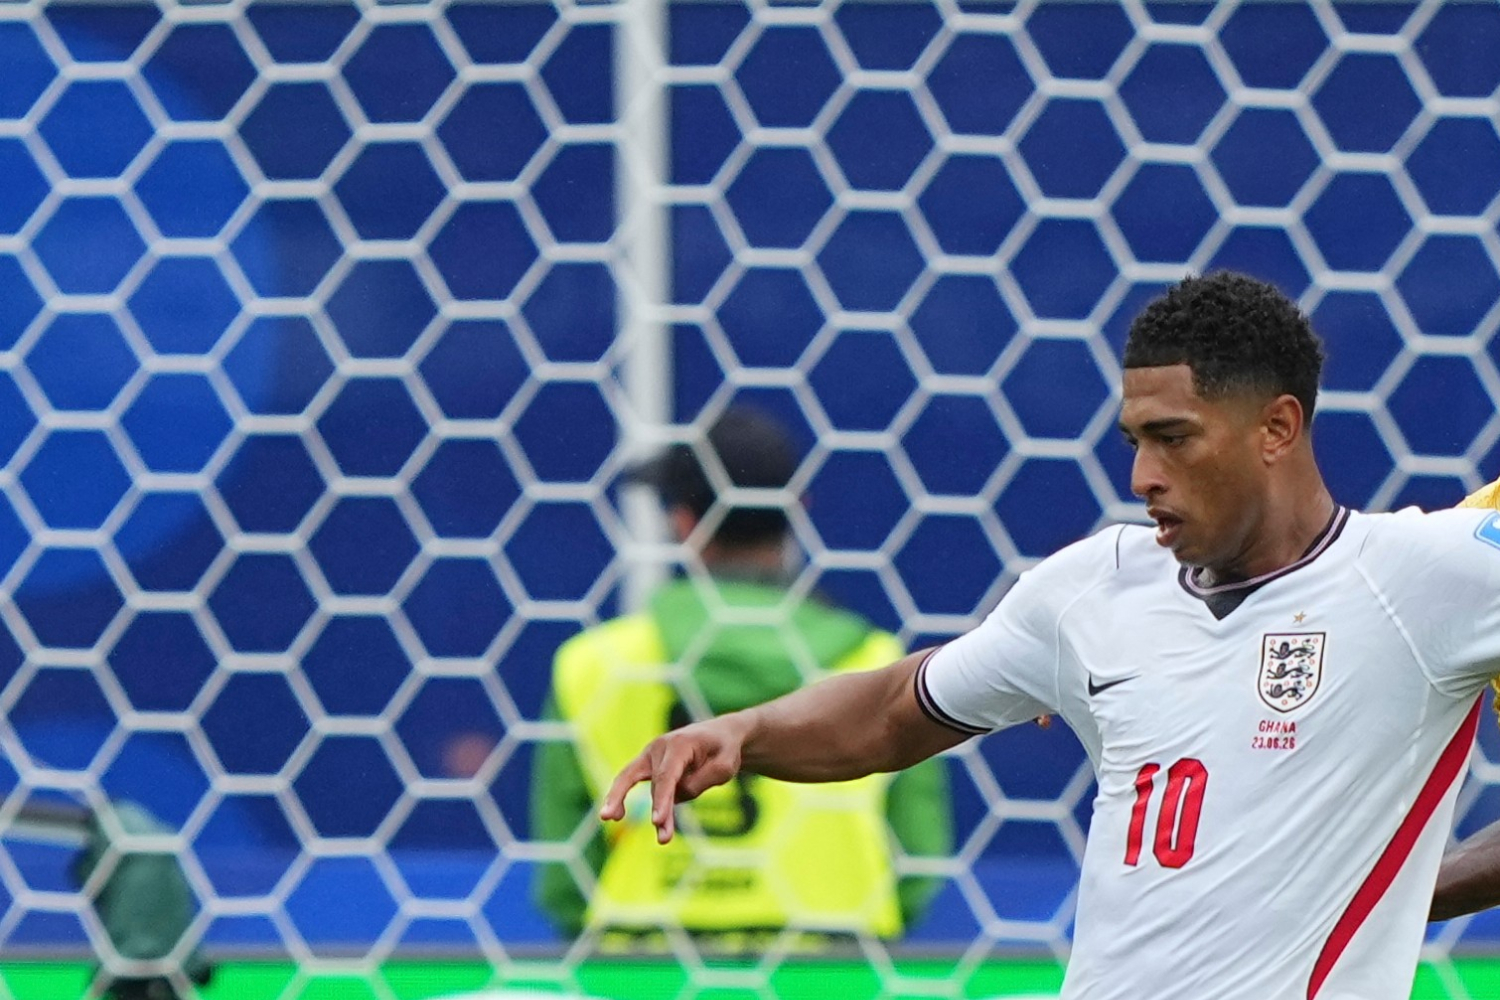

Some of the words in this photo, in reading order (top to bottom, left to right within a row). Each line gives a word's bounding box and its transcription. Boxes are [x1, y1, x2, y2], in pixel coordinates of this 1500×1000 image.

[1258, 720, 1296, 733] GHANA
[1251, 736, 1296, 749] 23.06.26
[1123, 757, 1208, 869] 10
